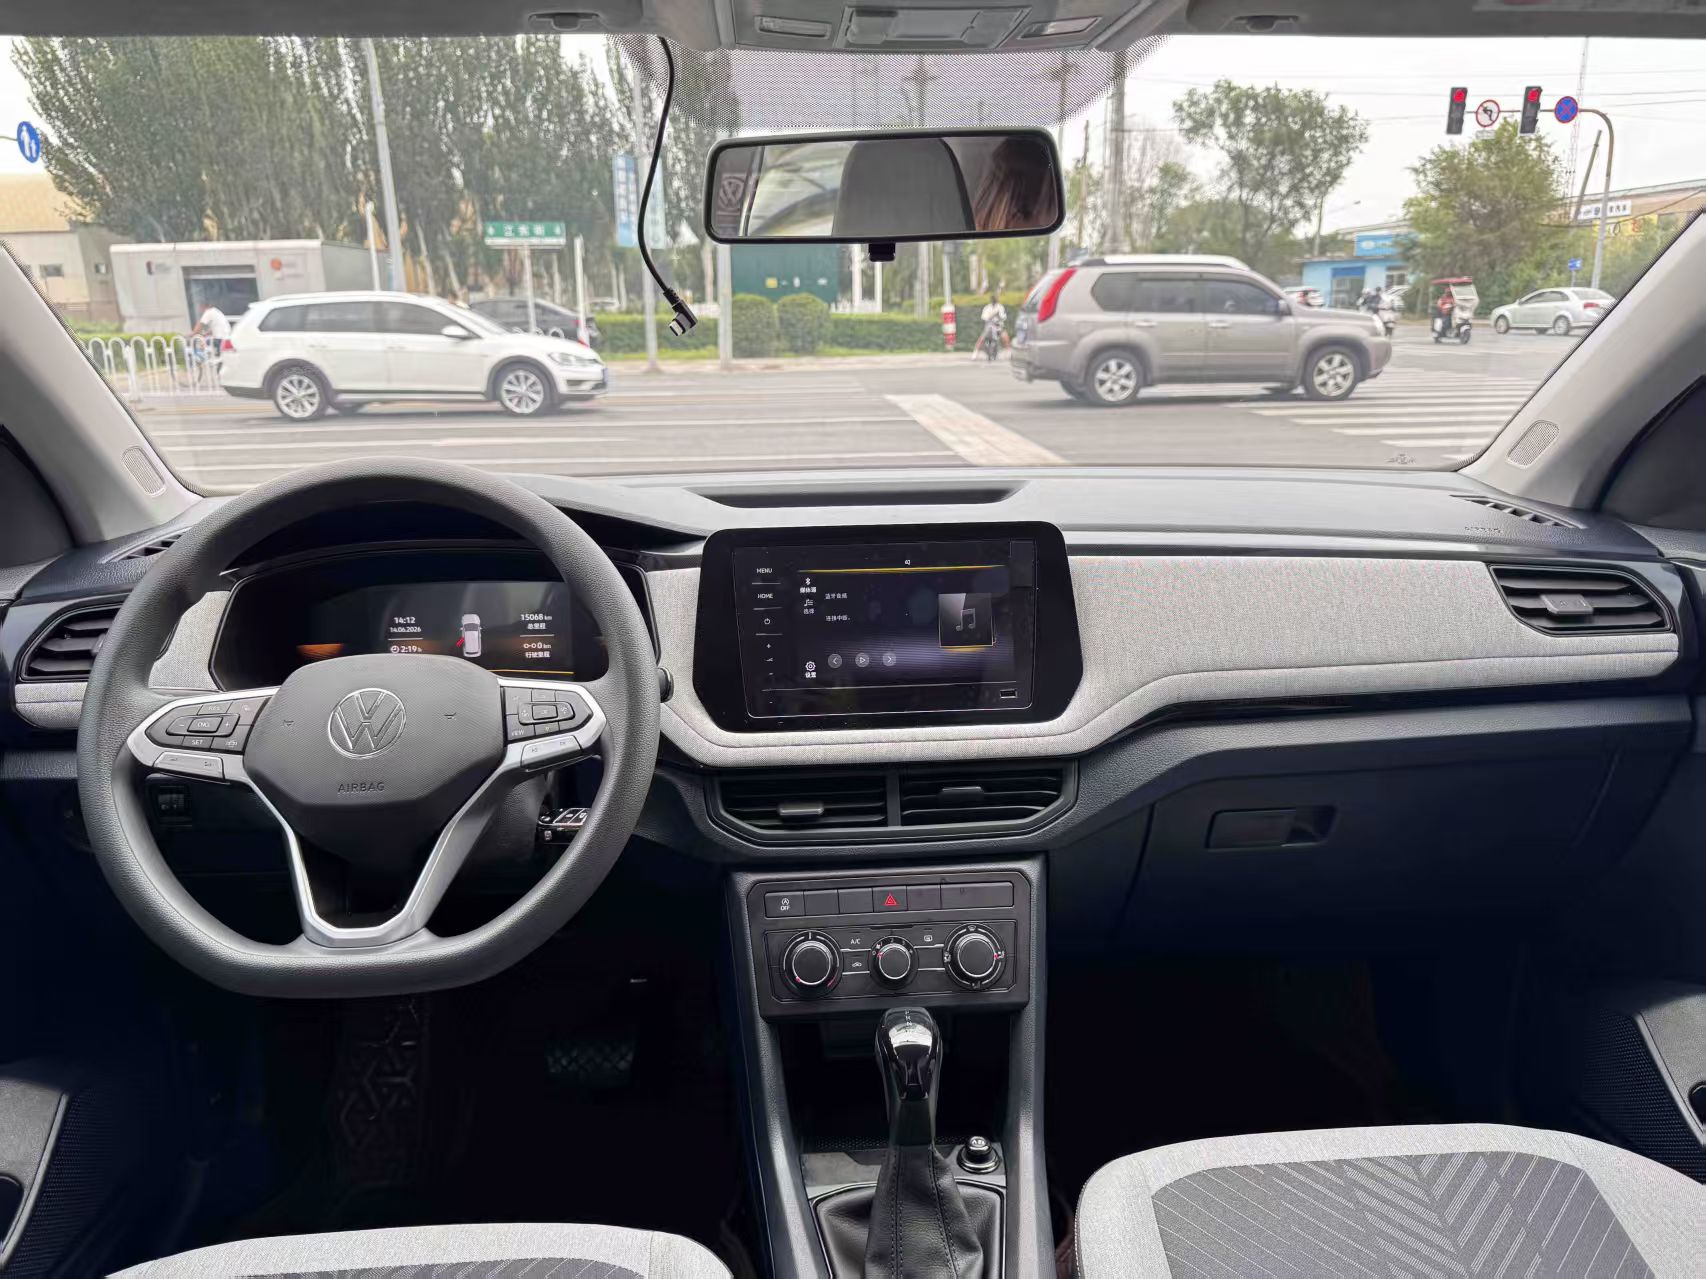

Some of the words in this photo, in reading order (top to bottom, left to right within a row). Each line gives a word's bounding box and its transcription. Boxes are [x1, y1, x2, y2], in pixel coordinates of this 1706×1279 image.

[393, 616, 416, 624] 14:12
[520, 613, 544, 621] 15068
[527, 622, 546, 630] 总里程
[400, 645, 418, 653] 2:19
[525, 651, 551, 659] 行驶里程
[337, 782, 386, 793] AIRBAG
